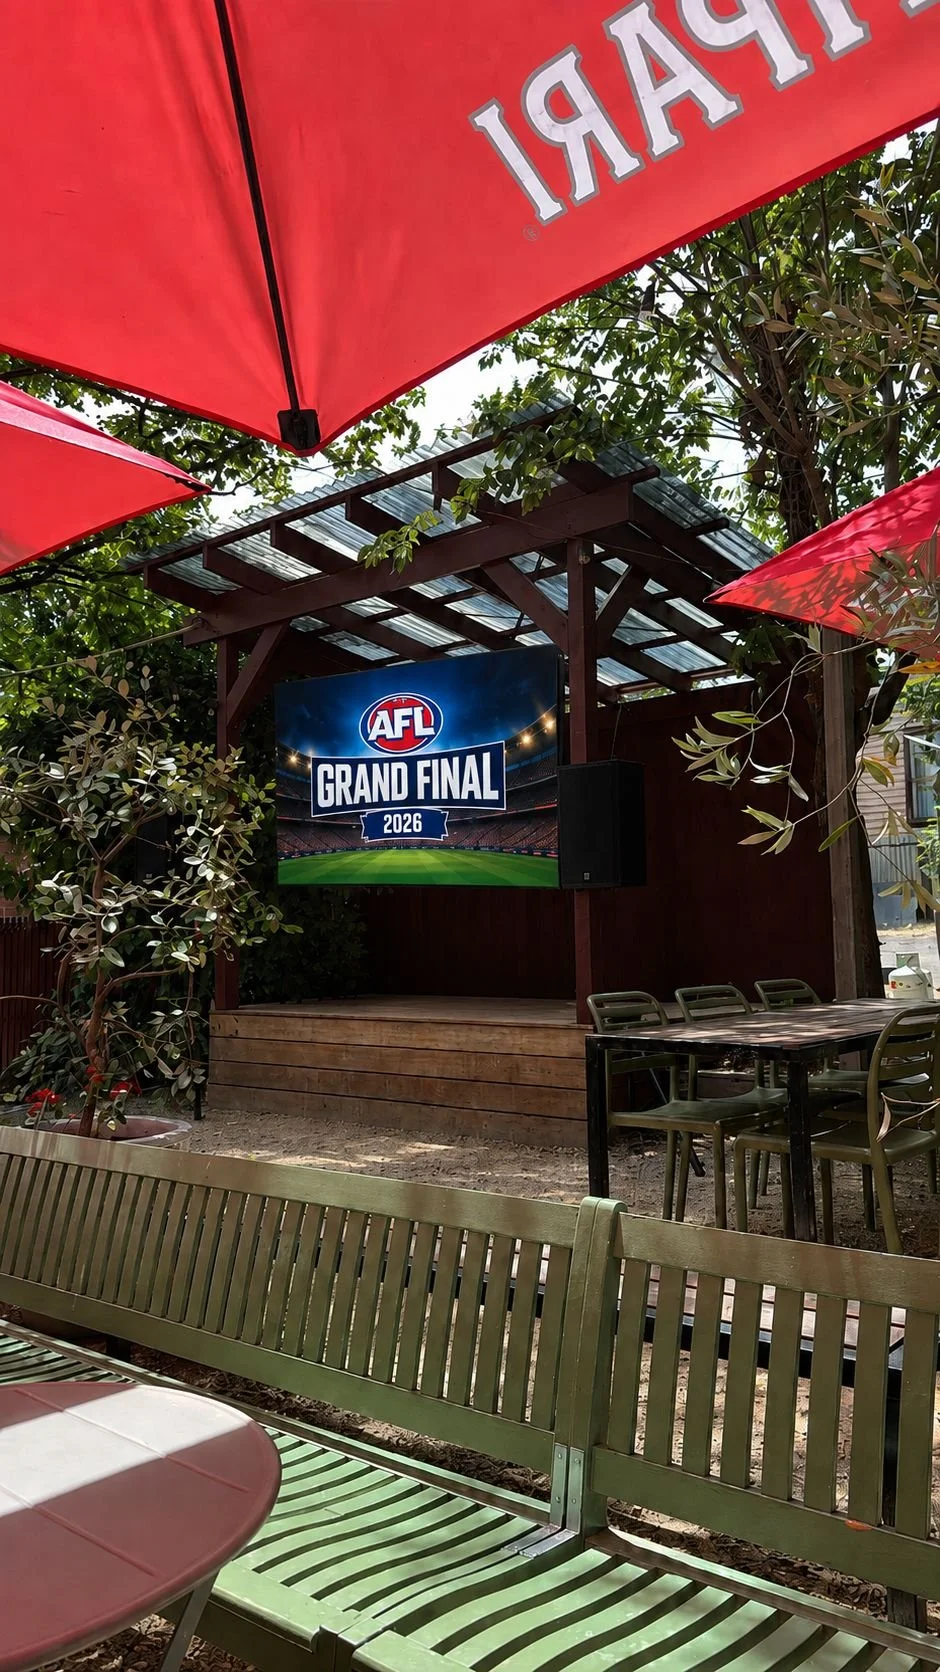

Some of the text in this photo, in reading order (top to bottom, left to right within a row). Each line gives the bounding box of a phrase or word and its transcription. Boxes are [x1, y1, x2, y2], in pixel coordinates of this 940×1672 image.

[368, 706, 436, 741] AFL
[316, 751, 499, 808] GRAND FINAL
[383, 813, 422, 834] 2026
